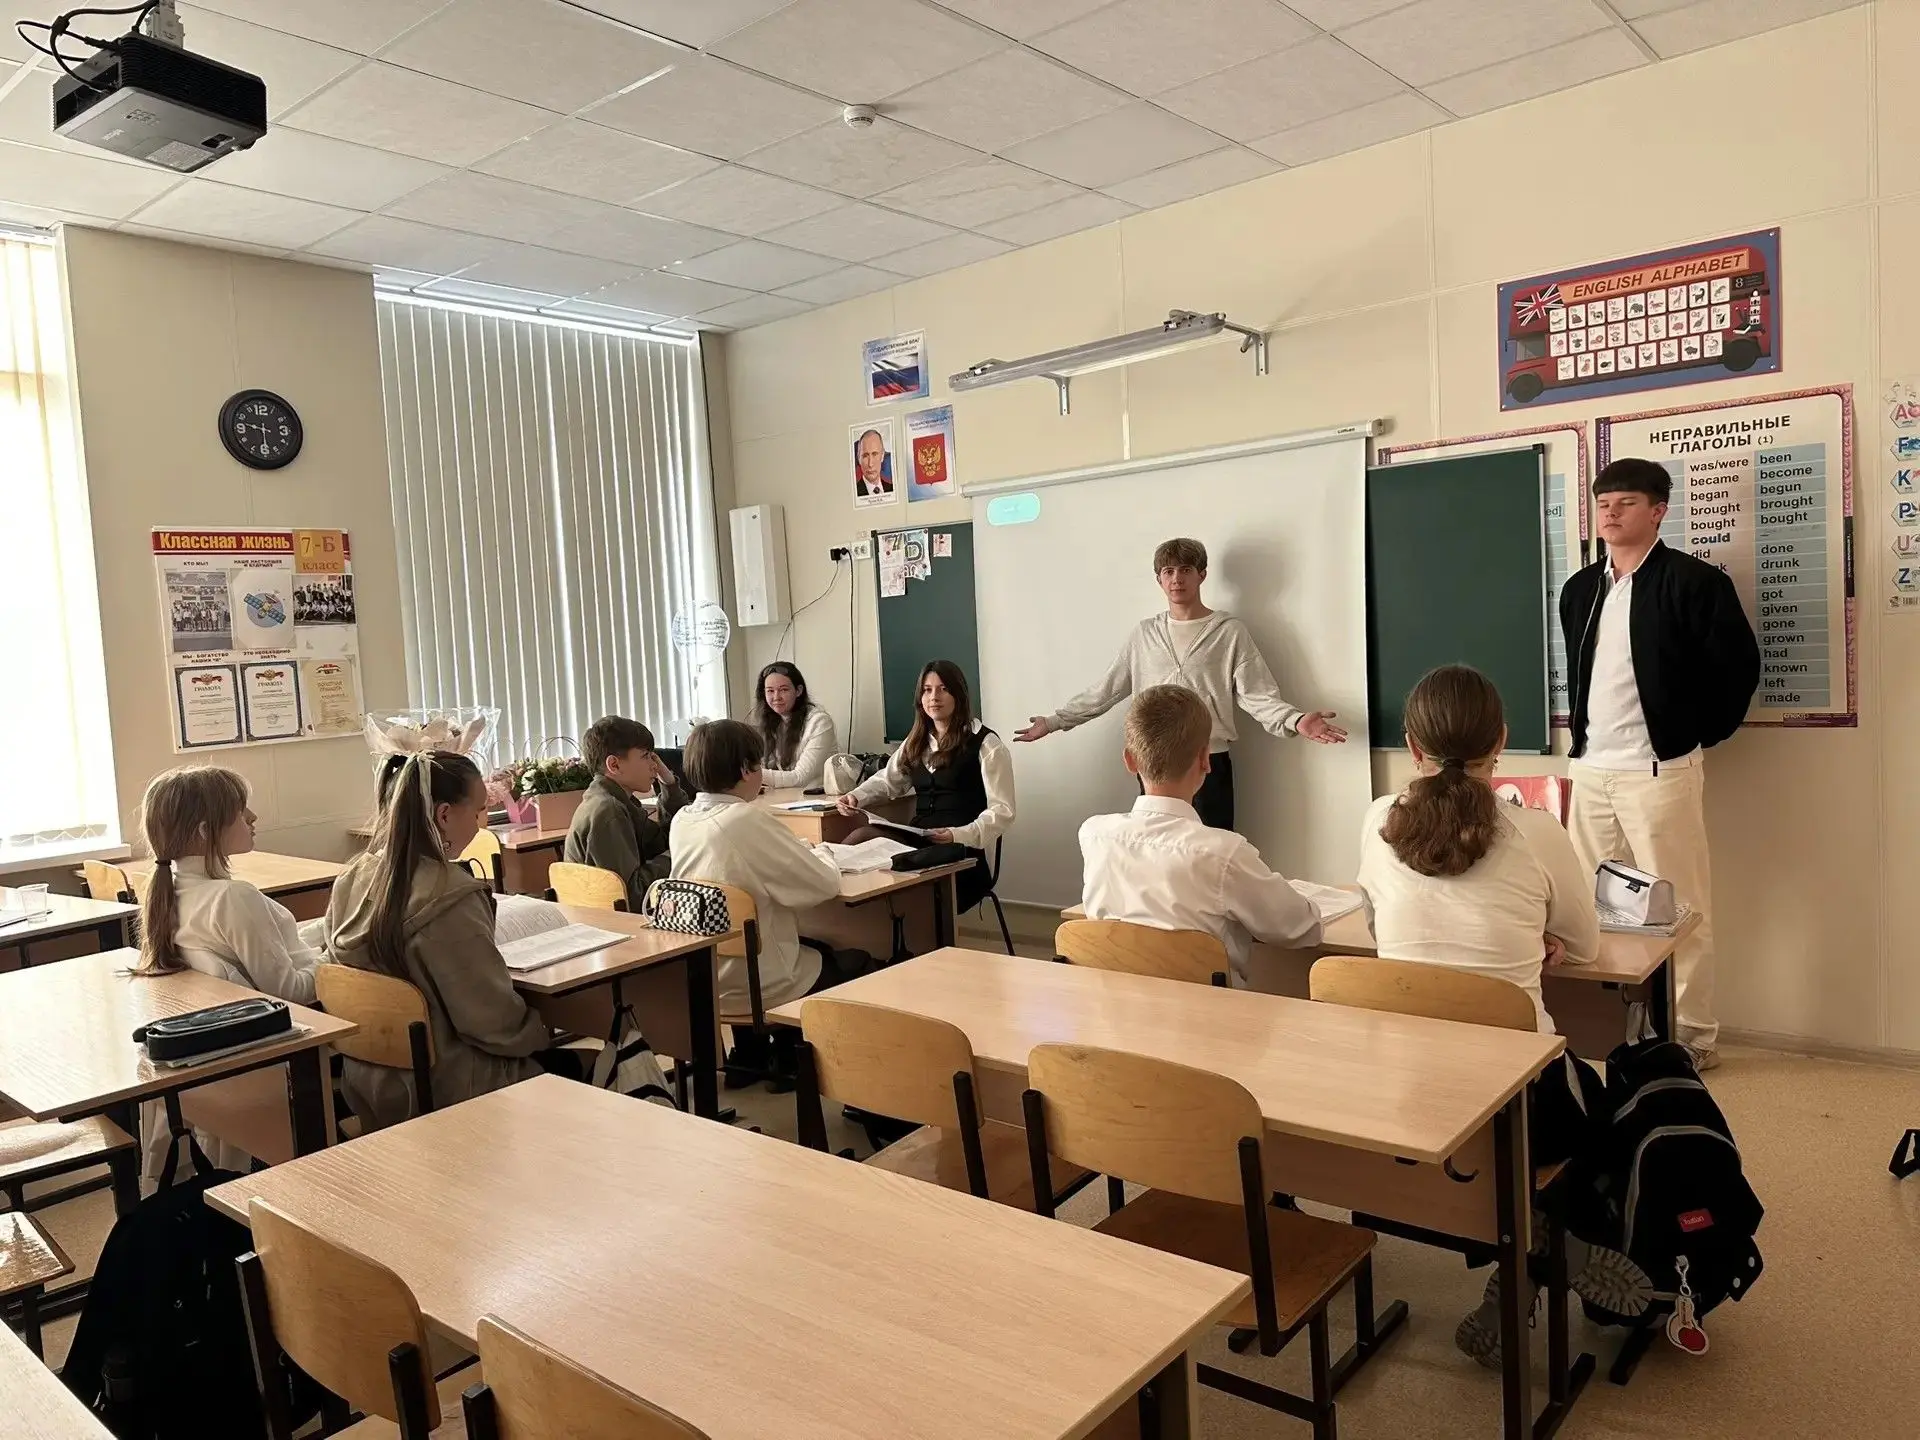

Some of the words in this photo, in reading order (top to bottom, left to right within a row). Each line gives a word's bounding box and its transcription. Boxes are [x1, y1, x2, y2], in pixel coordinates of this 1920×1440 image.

[1573, 273, 1643, 298] ENGLISH
[1651, 253, 1745, 284] ALPHABET
[1736, 278, 1743, 288] 8
[254, 404, 268, 416] 12
[236, 423, 246, 434] 9
[279, 425, 288, 436] 3
[1650, 415, 1790, 443] НЕПРАВИЛЬНЫЕ
[1671, 434, 1751, 454] ГЛАГОЛЫ
[1758, 435, 1773, 445] (1)
[1690, 459, 1748, 472] was/were
[1760, 453, 1792, 464] been
[1690, 474, 1739, 486] became
[1760, 465, 1812, 479] become
[1898, 470, 1911, 486] K
[1691, 490, 1728, 502] began
[1760, 481, 1801, 495] begun
[1545, 506, 1562, 517] ed]
[1691, 503, 1741, 516] brought
[1760, 495, 1813, 510] brought
[1899, 503, 1911, 518] P
[1691, 518, 1736, 530] bought
[1760, 511, 1808, 525] bought
[160, 532, 237, 550] Классная
[241, 534, 290, 550] жизнь
[300, 536, 336, 553] 7-Б
[1691, 533, 1730, 545] could
[1898, 535, 1910, 551] U
[1692, 550, 1710, 559] did
[1761, 544, 1793, 554] done
[303, 561, 338, 570] класс
[1761, 558, 1800, 569] drunk
[1761, 573, 1797, 584] eaten
[1899, 568, 1910, 583] Z
[1761, 589, 1783, 601] got
[1762, 603, 1798, 616] given
[1763, 619, 1795, 631] gone
[1763, 634, 1804, 646] grown
[1764, 648, 1788, 658] had
[1764, 663, 1808, 673] known
[1764, 678, 1785, 688] left
[1765, 693, 1800, 703] made
